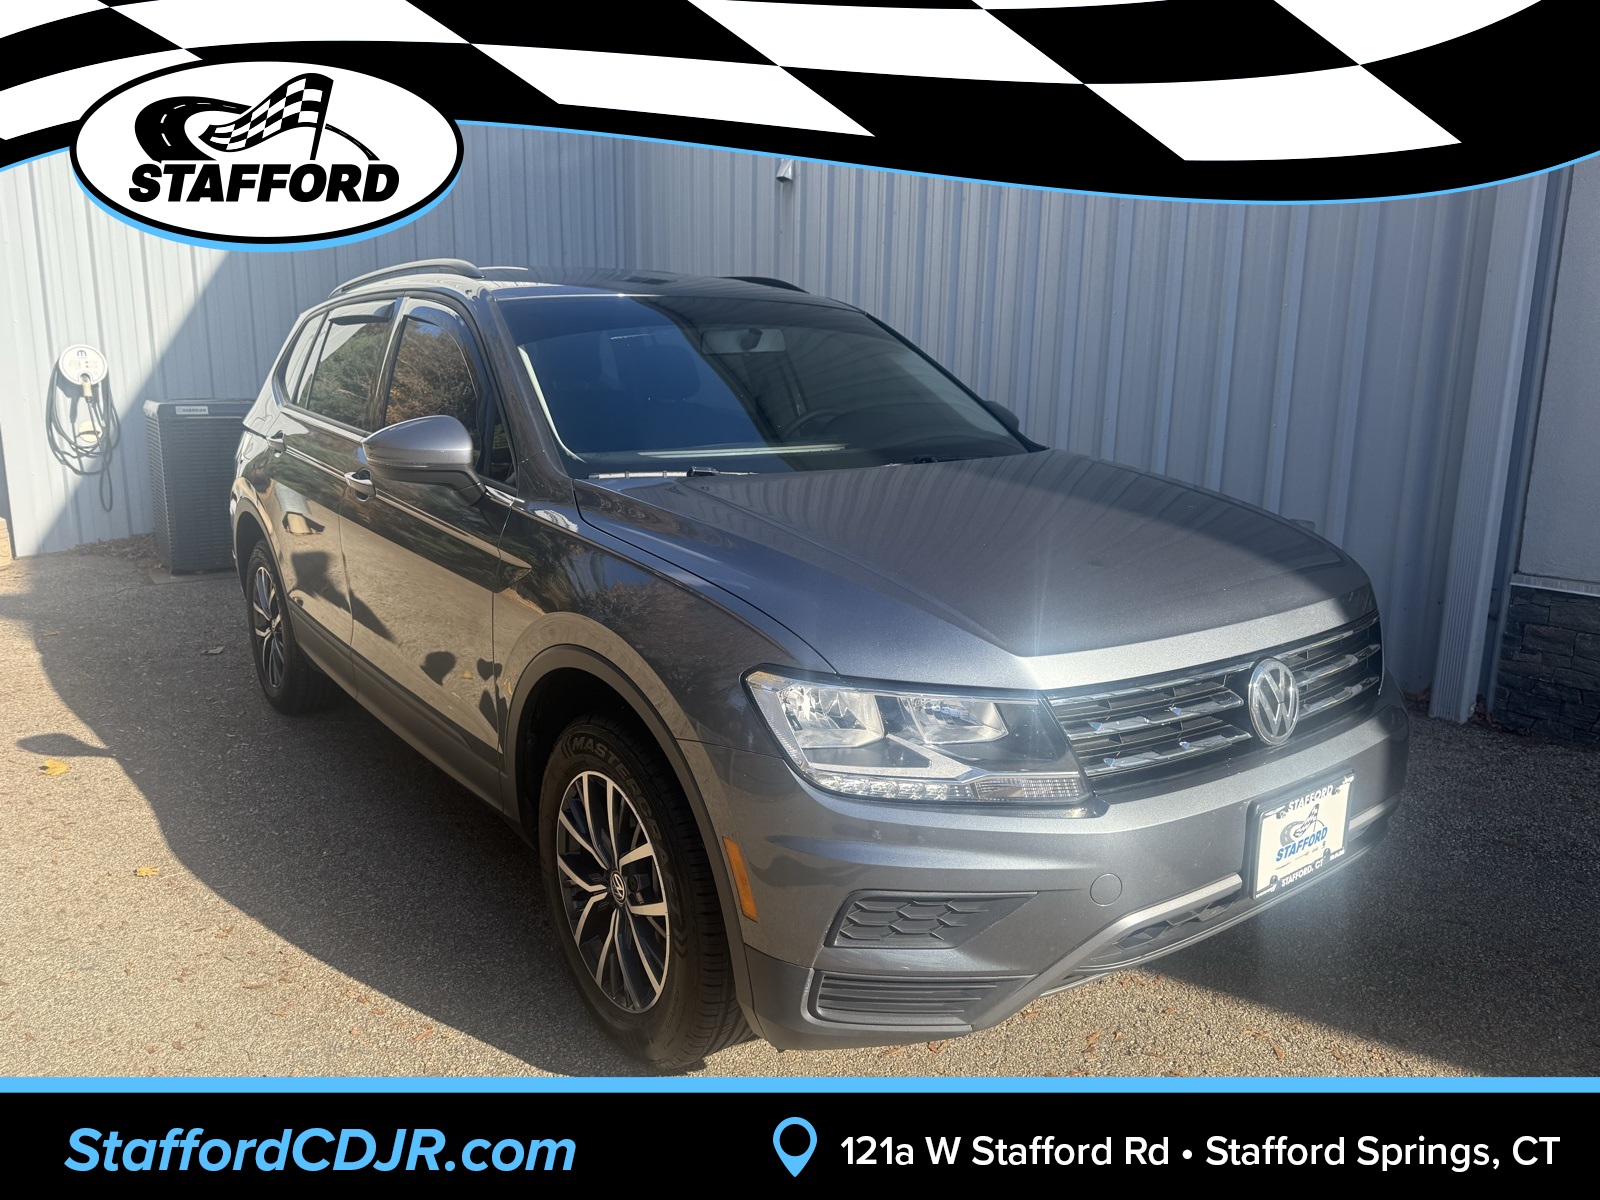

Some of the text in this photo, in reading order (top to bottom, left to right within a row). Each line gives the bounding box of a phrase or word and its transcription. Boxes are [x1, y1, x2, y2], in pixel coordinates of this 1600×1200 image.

[1288, 784, 1334, 811] STAFFORD
[1275, 826, 1329, 863] STAFFORD
[1281, 859, 1324, 888] STAFFORD, CT
